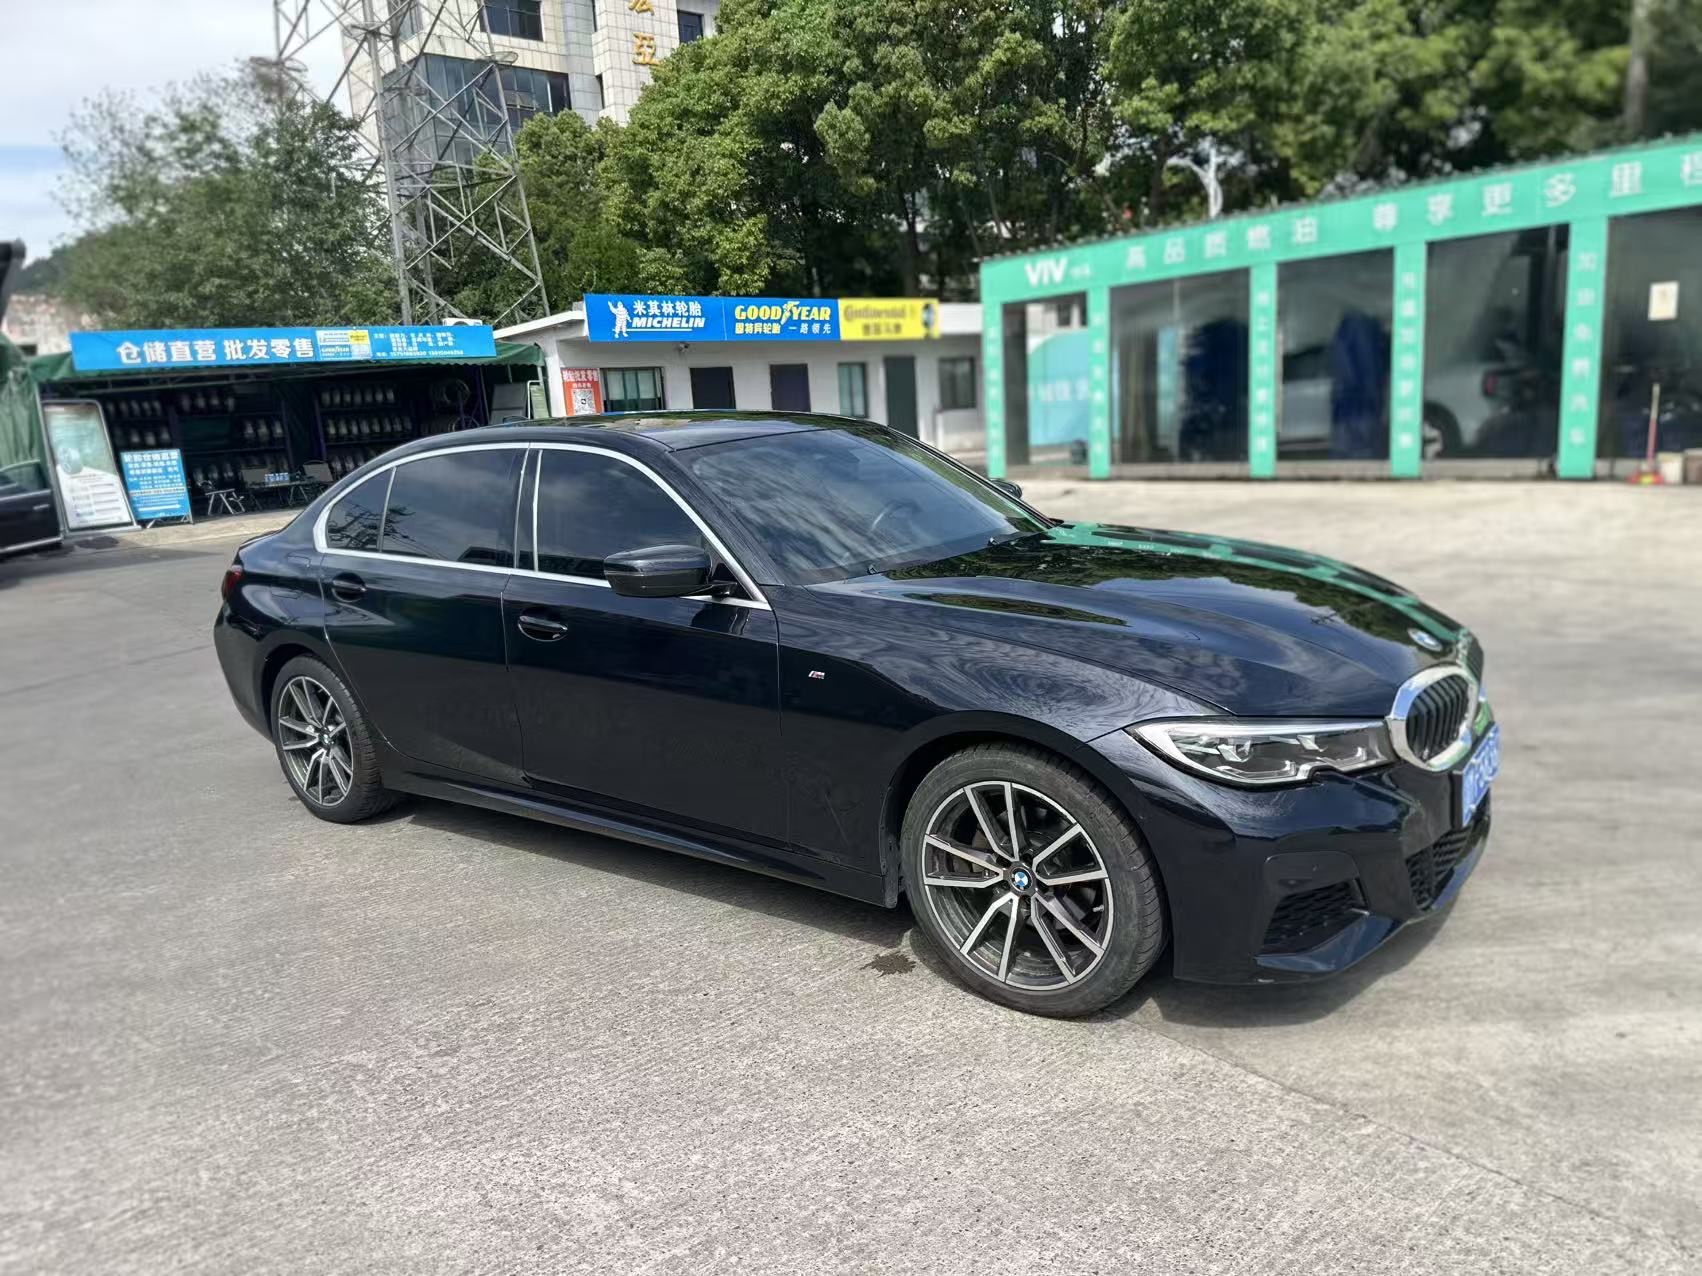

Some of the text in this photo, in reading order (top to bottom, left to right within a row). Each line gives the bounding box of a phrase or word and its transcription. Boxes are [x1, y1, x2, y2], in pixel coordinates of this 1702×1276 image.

[1024, 257, 1068, 288] VIV
[633, 300, 702, 316] 米其林轮胎
[632, 316, 706, 328] MICHELIN
[788, 323, 831, 334] 一路领先
[116, 339, 217, 364] 仓储直营
[223, 338, 314, 360] 批发零售
